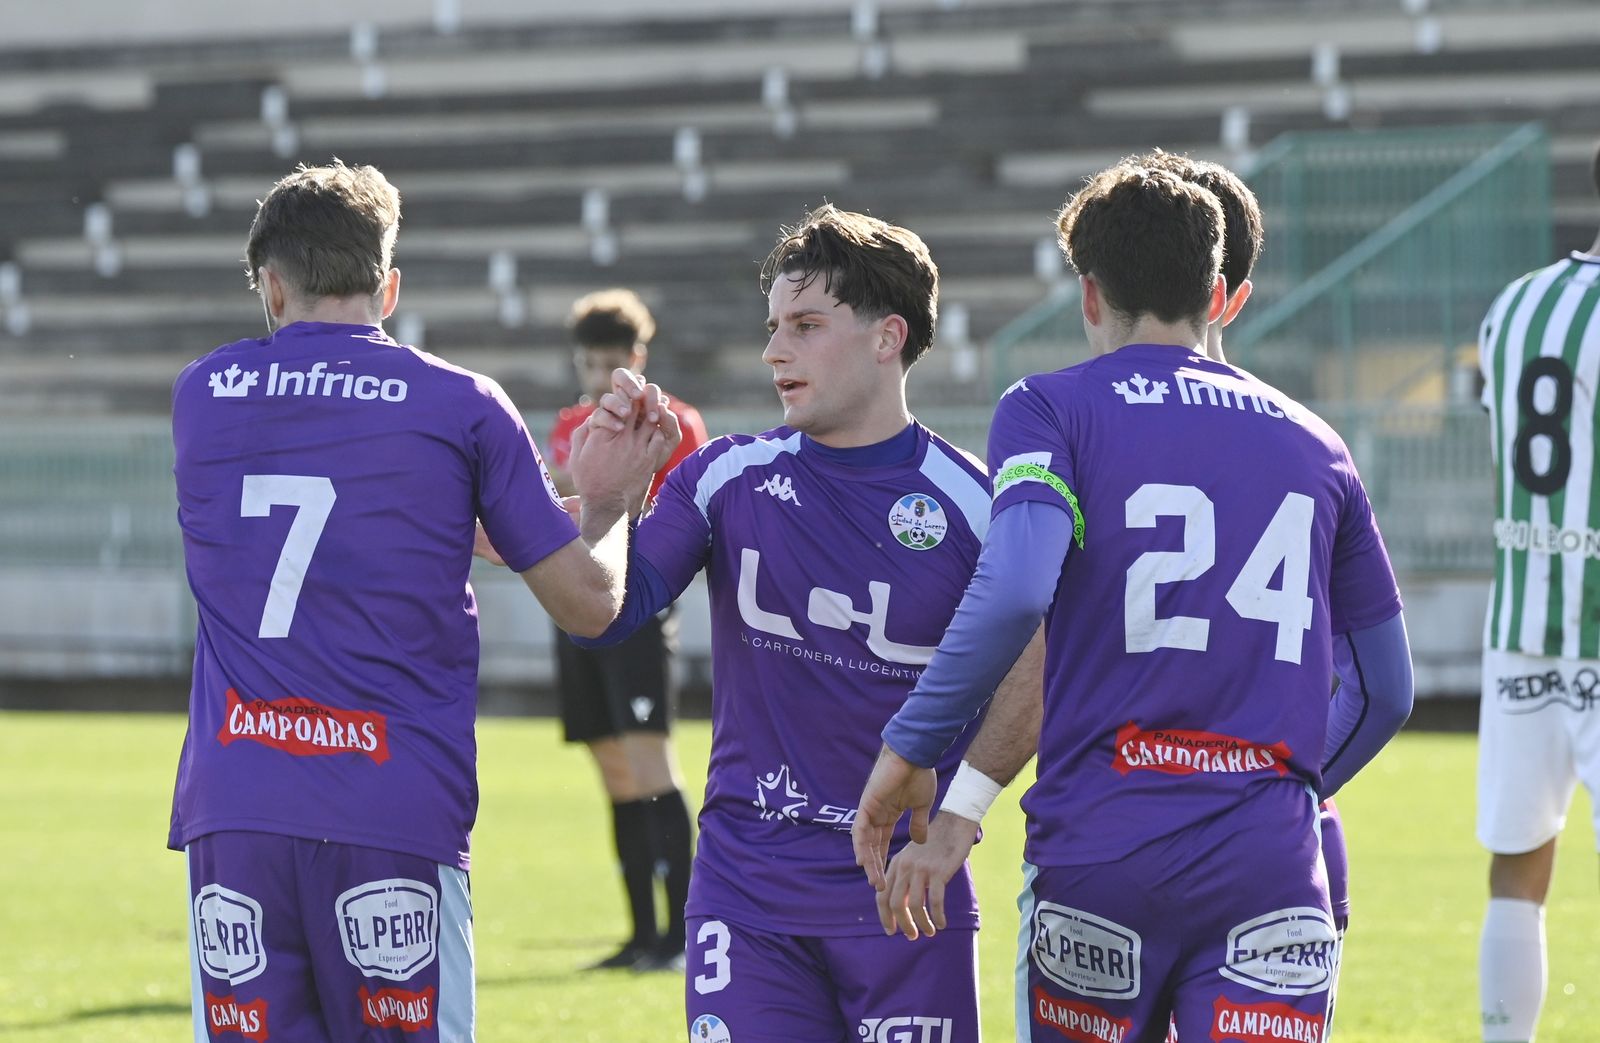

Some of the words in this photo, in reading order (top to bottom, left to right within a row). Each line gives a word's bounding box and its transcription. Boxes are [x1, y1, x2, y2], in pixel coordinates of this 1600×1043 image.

[266, 362, 408, 402] Infrico
[1512, 356, 1573, 496] 8
[240, 474, 337, 639] 7
[1125, 483, 1315, 665] 24
[752, 637, 843, 667] CARTONERA
[848, 661, 922, 679] LUCENTIN
[229, 703, 378, 752] CAMPOARAS
[1153, 732, 1239, 749] PANADERIA
[344, 916, 369, 950] EL
[694, 920, 732, 995] 3
